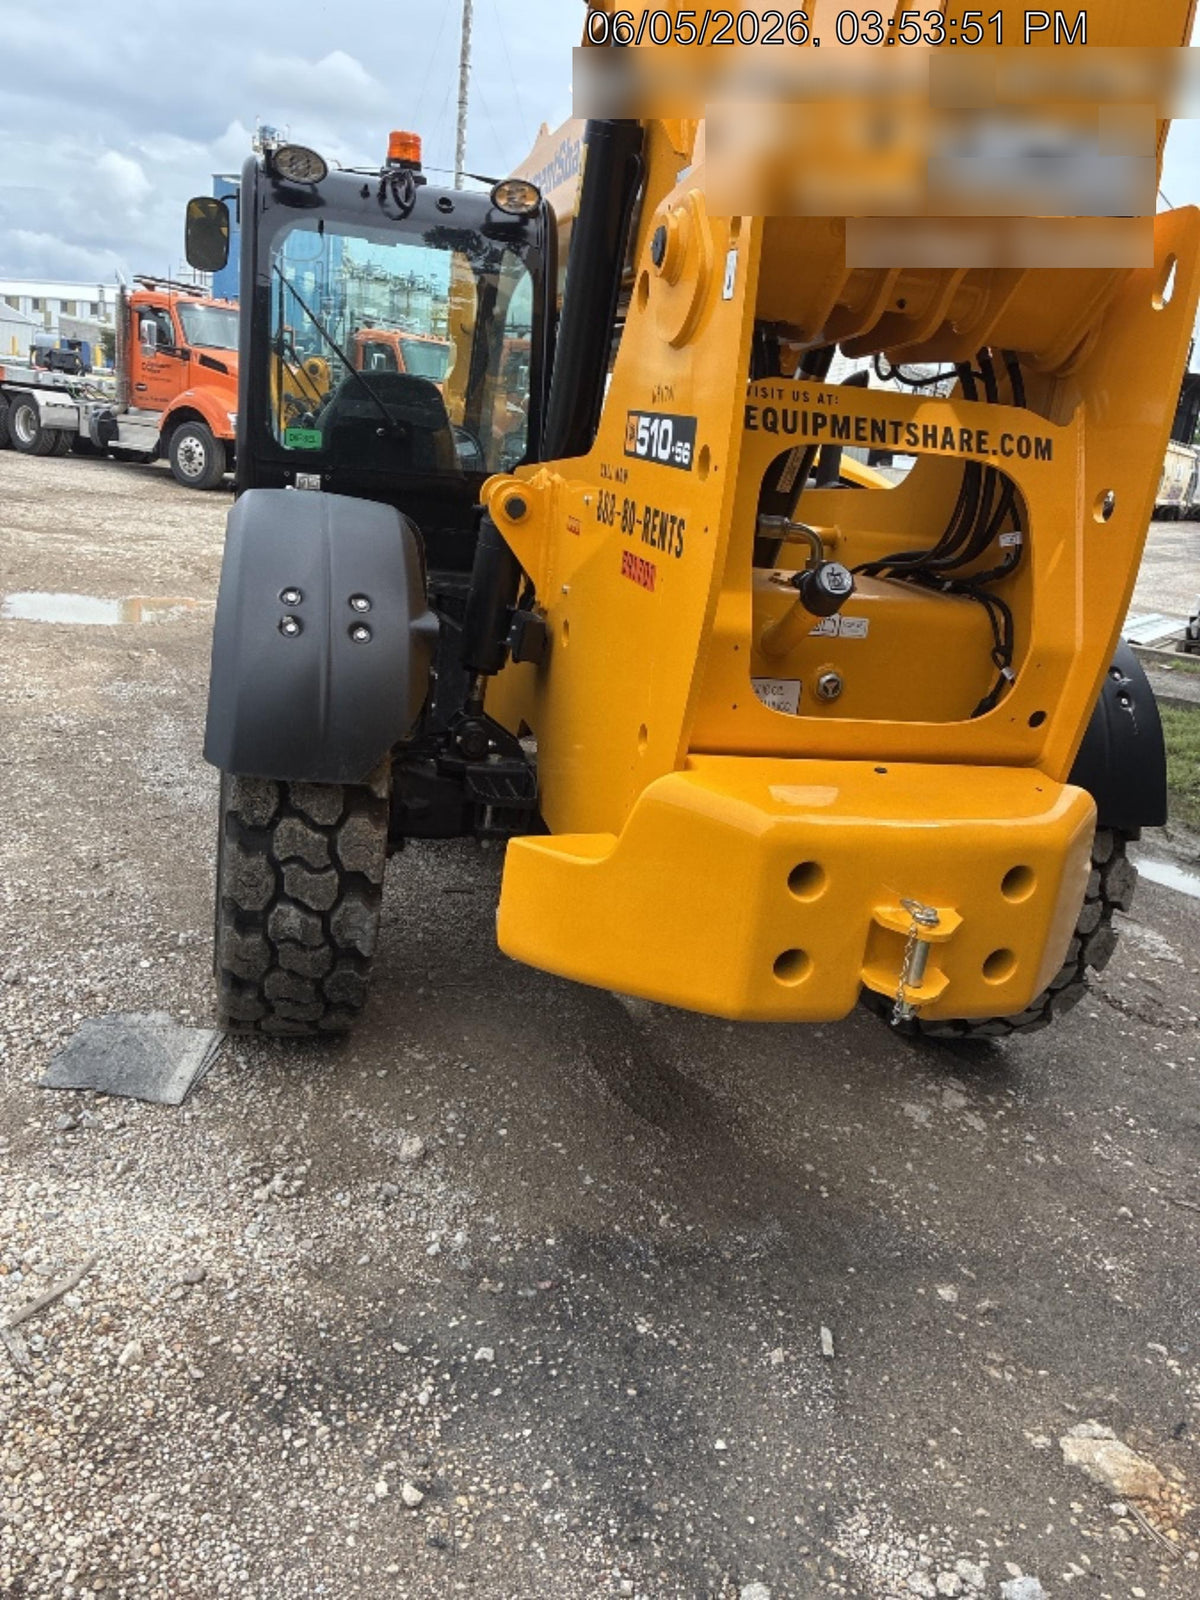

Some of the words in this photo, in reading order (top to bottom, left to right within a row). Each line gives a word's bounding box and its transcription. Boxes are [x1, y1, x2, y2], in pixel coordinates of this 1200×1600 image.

[792, 391, 810, 403] US
[817, 393, 839, 405] AT:
[744, 405, 1053, 461] EQUIPMENTSHARE.COM
